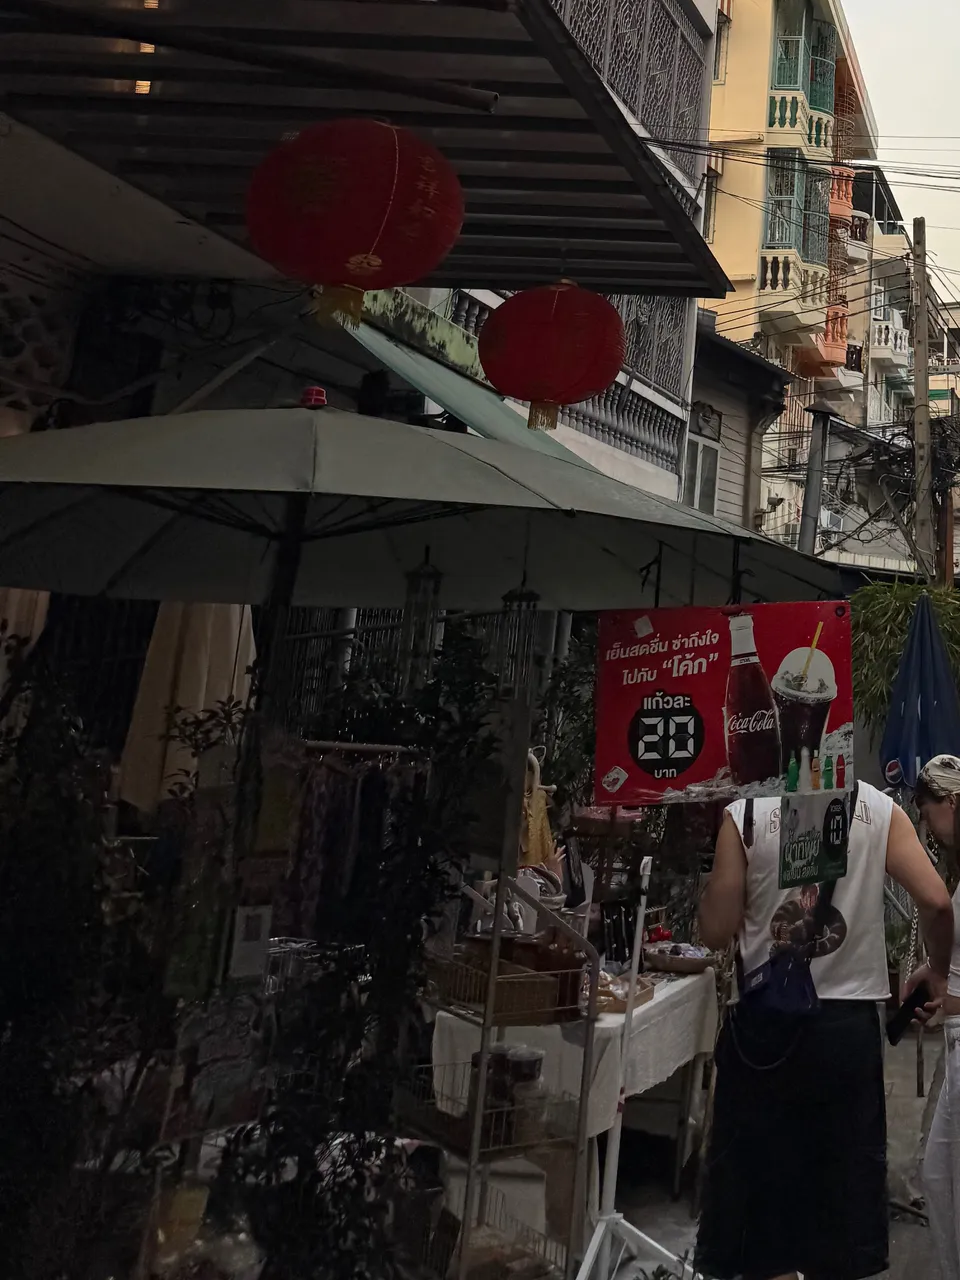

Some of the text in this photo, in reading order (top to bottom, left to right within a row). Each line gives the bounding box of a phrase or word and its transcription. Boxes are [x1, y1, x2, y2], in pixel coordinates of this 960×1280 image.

[605, 629, 720, 661] เย็นสดชื่น ซ่าถึงใจ
[622, 667, 657, 686] ไปกับ
[643, 691, 691, 710] แก้วละ
[727, 709, 775, 736] Coca-Cola
[637, 715, 696, 760] 20
[654, 767, 677, 779] บาท
